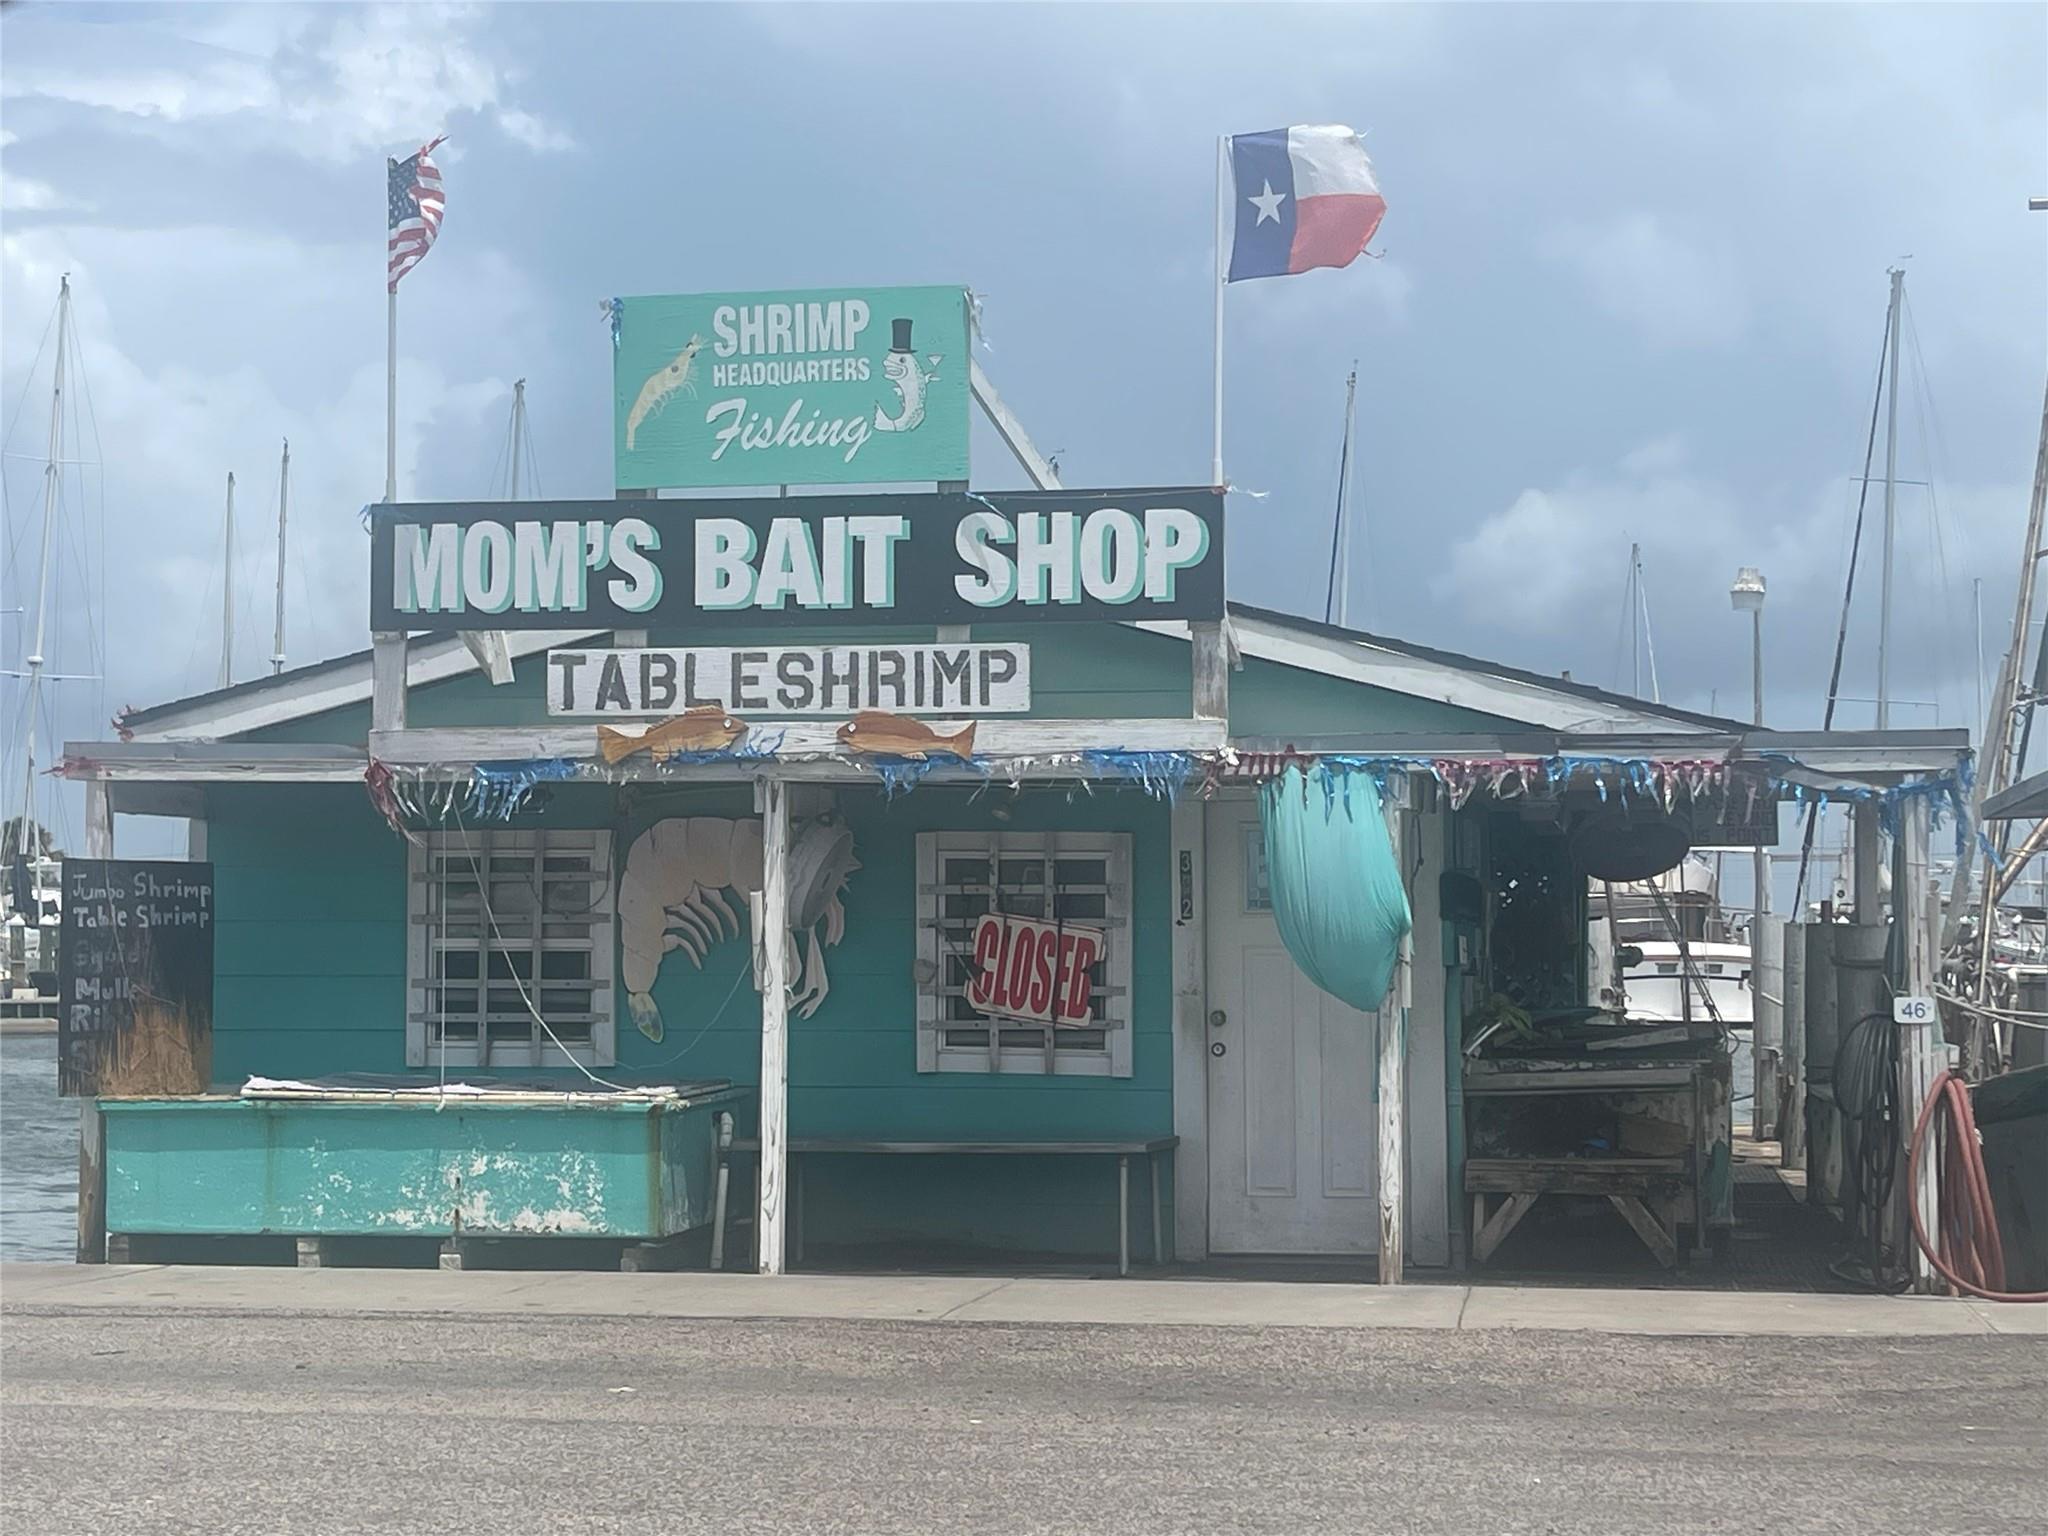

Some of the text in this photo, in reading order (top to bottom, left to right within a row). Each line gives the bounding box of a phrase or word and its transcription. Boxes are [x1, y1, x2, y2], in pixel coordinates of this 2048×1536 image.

[713, 299, 870, 357] SHRIMP
[713, 357, 870, 388] HEADQUARTERS
[706, 398, 872, 463] Fishing
[393, 508, 1209, 613] MOM'S BAIT SHOP
[72, 871, 212, 908] Jumbo Shrimp
[72, 904, 210, 929] Table Shrimp
[972, 919, 1097, 1019] CLOSED
[1902, 1001, 1926, 1019] 46
